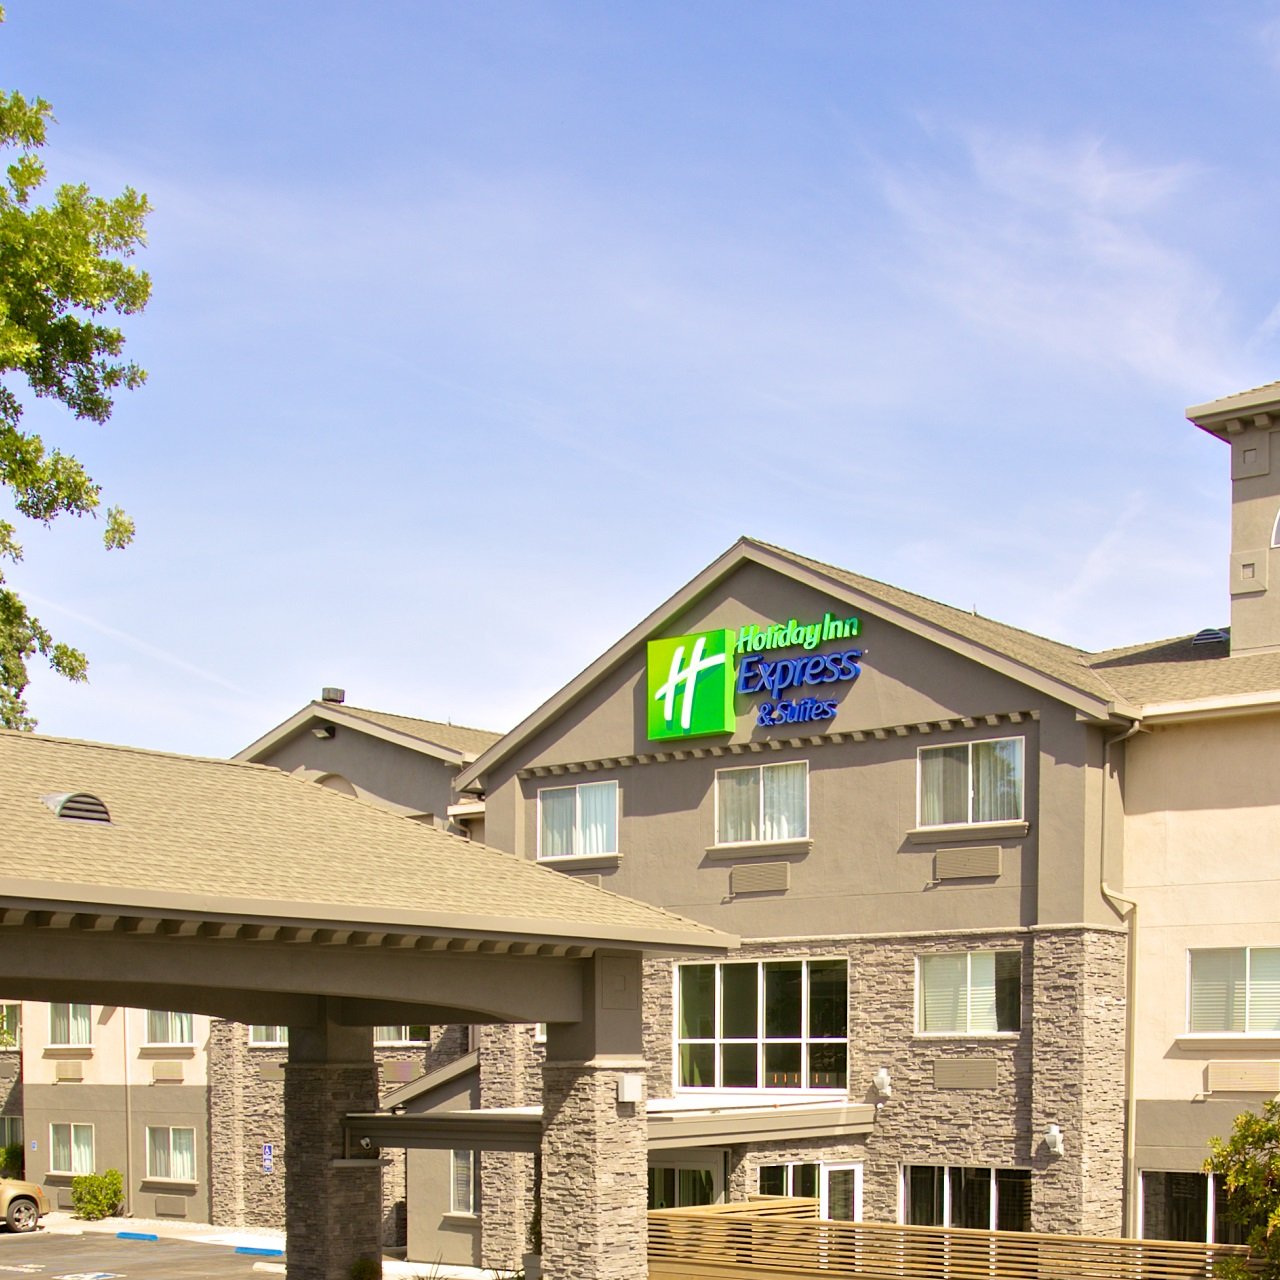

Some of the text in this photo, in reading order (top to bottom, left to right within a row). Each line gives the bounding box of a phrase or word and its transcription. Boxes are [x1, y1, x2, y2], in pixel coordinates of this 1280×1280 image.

[735, 611, 862, 653] Holiday Inn
[737, 650, 863, 699] Express
[757, 697, 839, 727] & Suites
